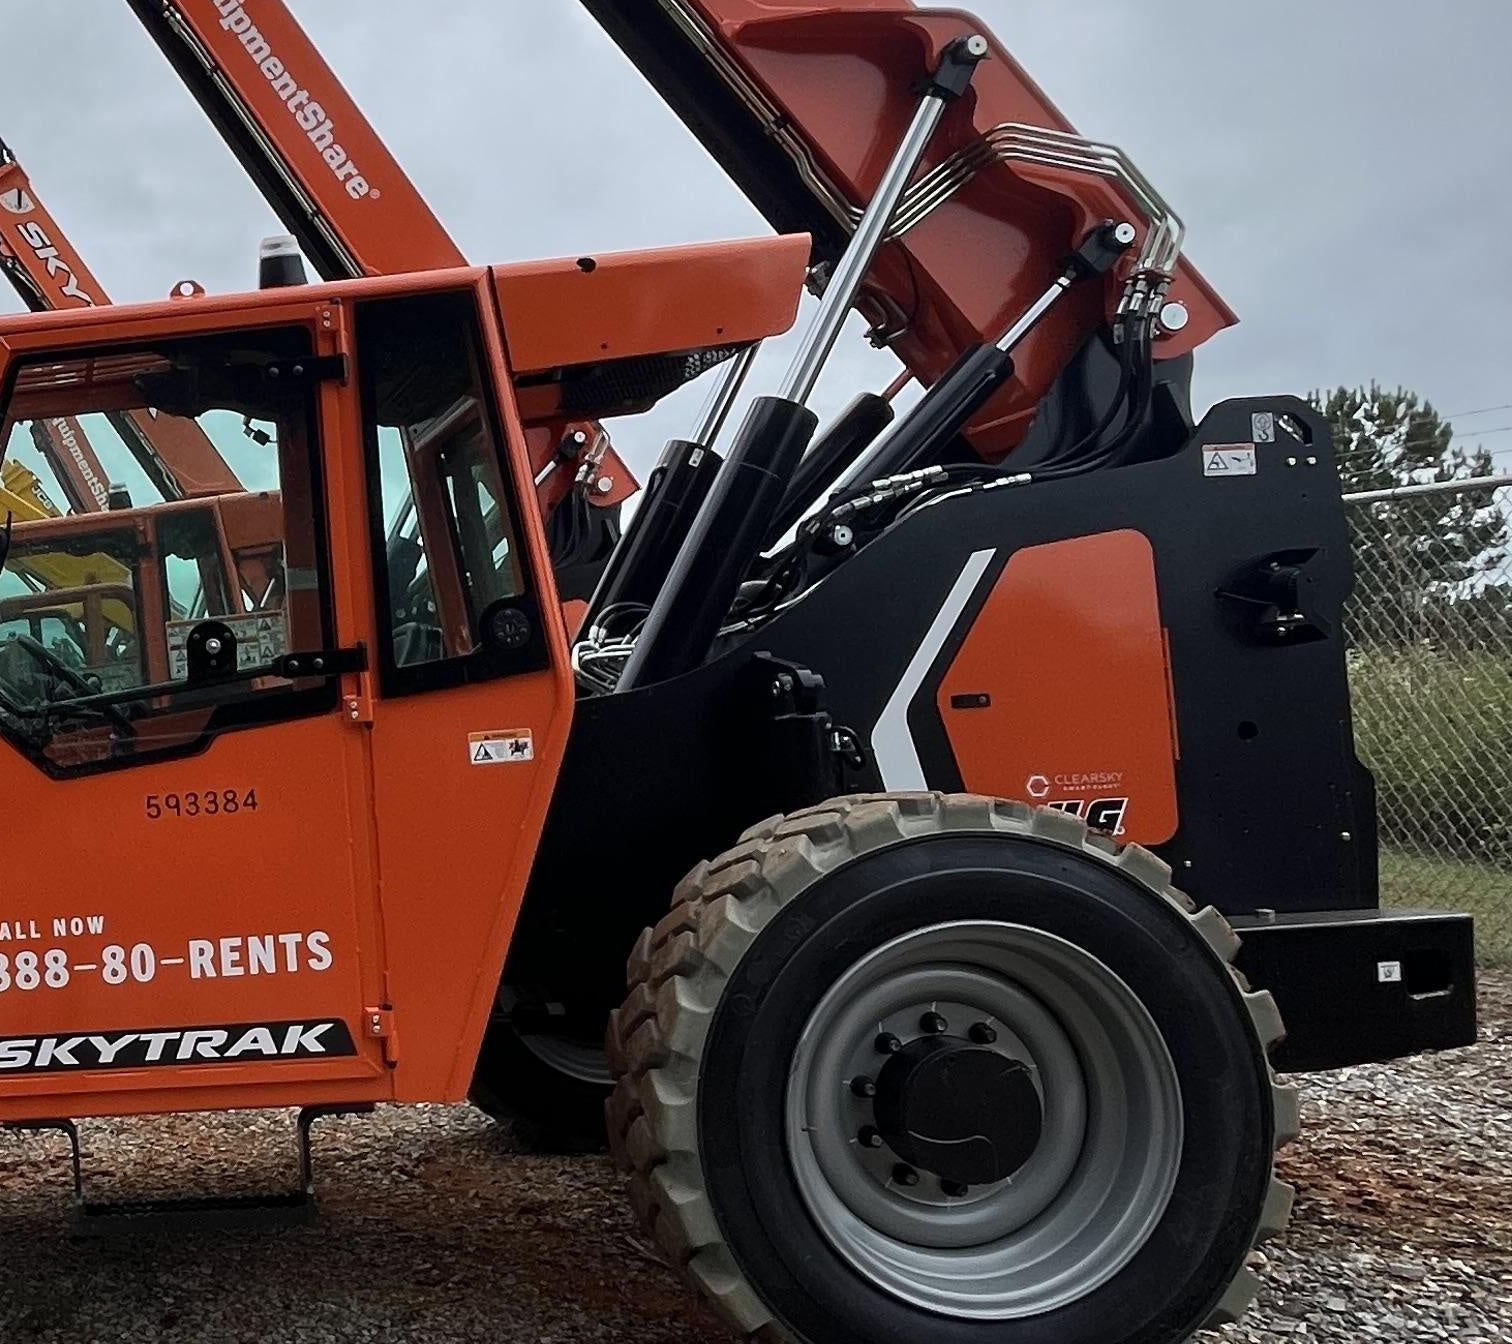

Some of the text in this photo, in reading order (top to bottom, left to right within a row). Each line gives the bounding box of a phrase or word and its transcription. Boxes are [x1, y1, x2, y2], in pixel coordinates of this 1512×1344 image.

[1054, 772, 1123, 785] CLEARSKY
[145, 789, 259, 820] 593384
[53, 915, 105, 938] NOW
